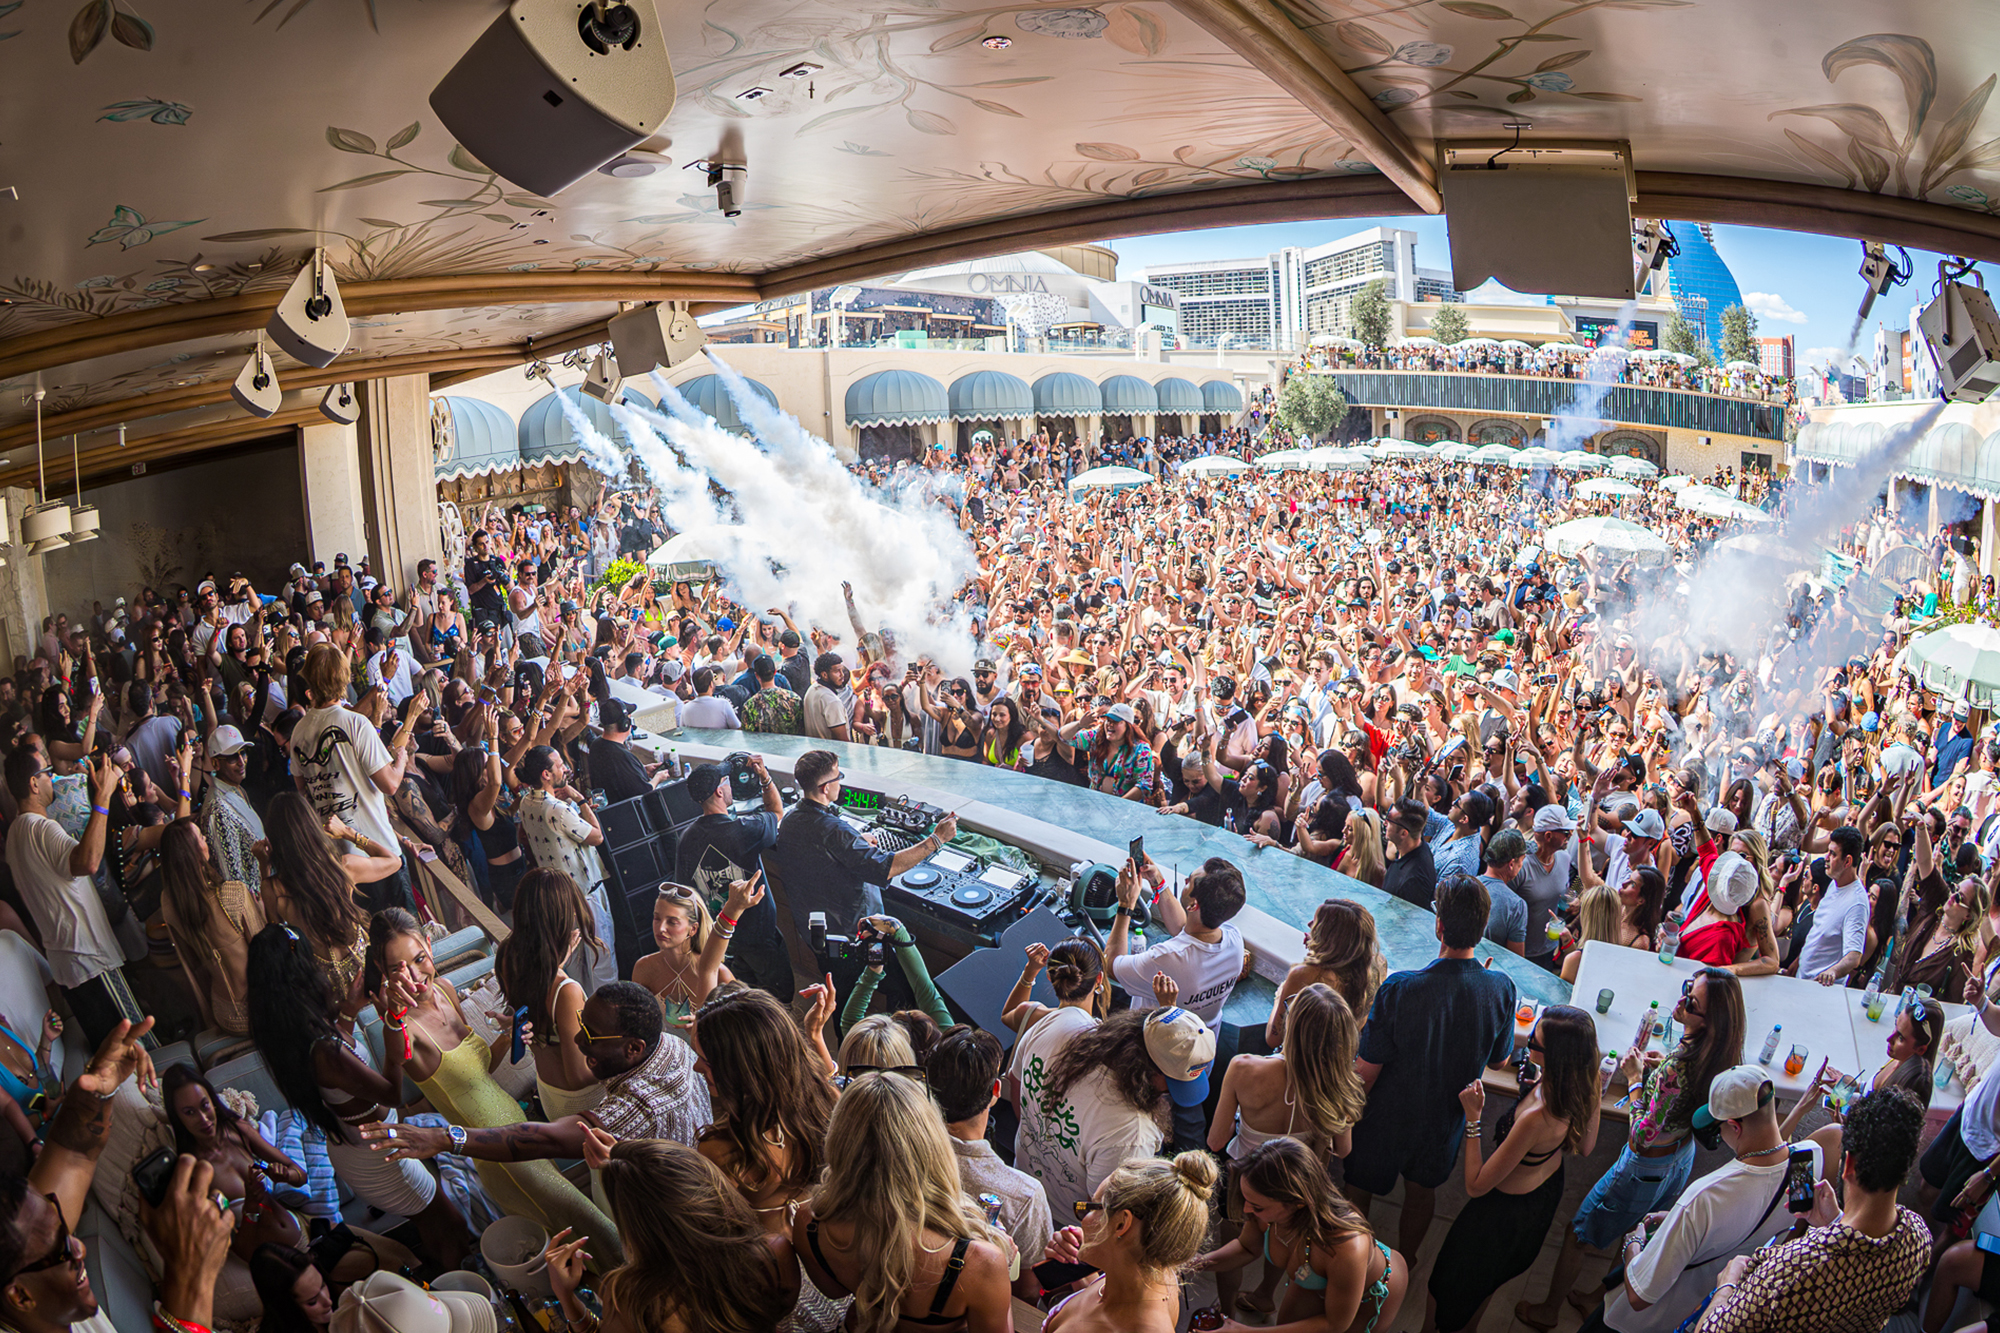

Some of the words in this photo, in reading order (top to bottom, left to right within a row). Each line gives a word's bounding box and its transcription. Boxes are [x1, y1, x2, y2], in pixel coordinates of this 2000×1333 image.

[968, 273, 1049, 293] OMNIA
[1140, 285, 1174, 307] OMNIA
[843, 789, 870, 809] 3:44
[700, 865, 734, 886] VIPER
